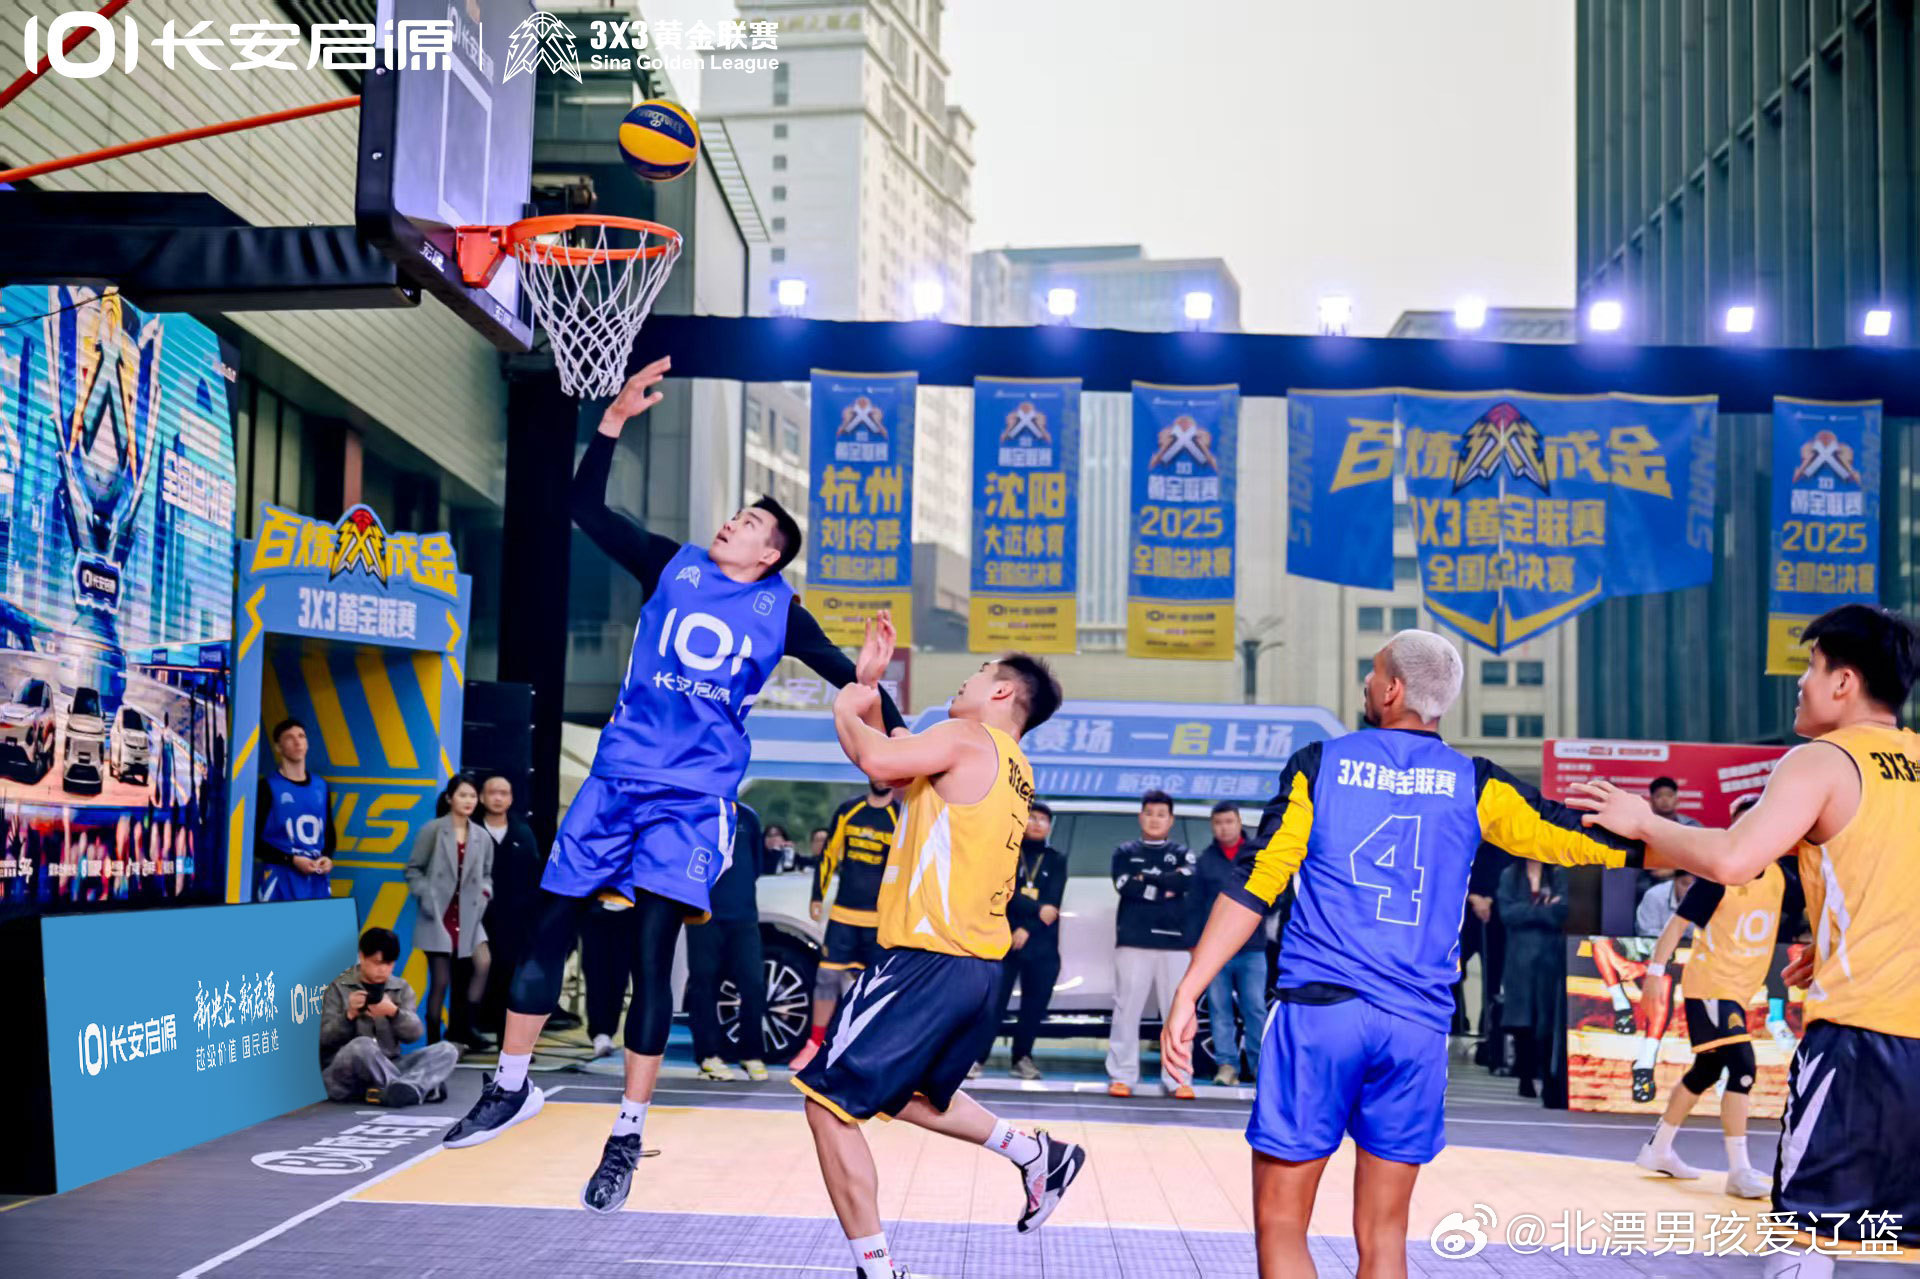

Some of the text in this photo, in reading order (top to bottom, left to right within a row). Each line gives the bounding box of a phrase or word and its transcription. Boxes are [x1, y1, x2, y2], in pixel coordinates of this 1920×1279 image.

[820, 464, 903, 513] 杭州
[984, 471, 1066, 519] 沈阳
[1140, 505, 1223, 538] 2025
[1782, 520, 1868, 552] 2025
[984, 524, 1065, 557] 大迈体育
[820, 554, 897, 581] 全国总决赛
[984, 561, 1062, 586] 全国总决赛
[1133, 544, 1231, 578] 全国总决赛
[1427, 552, 1576, 592] 全国总决赛
[1776, 560, 1875, 593] 全国总决赛
[298, 587, 417, 641] 3X3黄金联赛
[1116, 773, 1184, 795] 新央企
[1337, 758, 1457, 799] 3X3黄金联赛
[1350, 814, 1425, 927] 4
[110, 1014, 177, 1064] 长安启源
[242, 1028, 279, 1059] 国民首选
